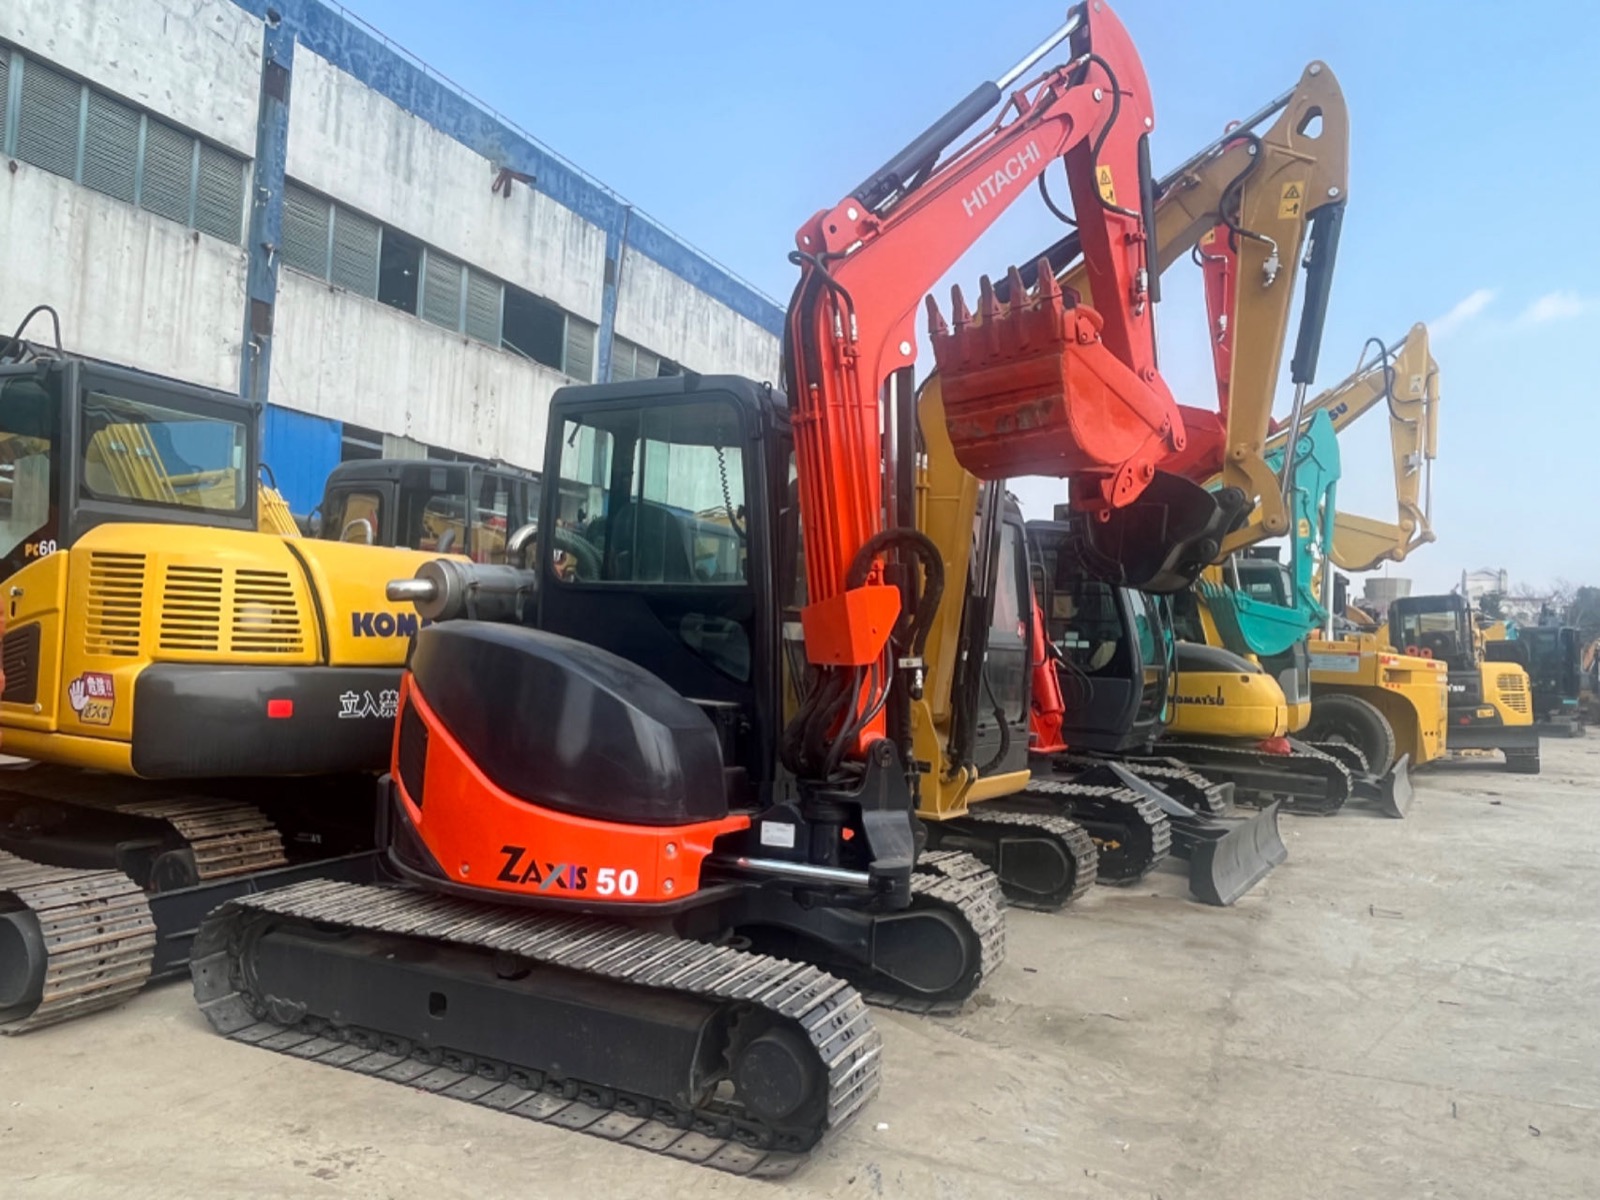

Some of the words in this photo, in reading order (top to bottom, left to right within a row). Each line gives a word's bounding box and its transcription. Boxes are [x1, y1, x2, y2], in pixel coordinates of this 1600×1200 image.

[961, 140, 1041, 217] HITACHI
[24, 539, 57, 557] PC60
[496, 845, 588, 890] ZAXIS
[596, 867, 639, 896] 50
